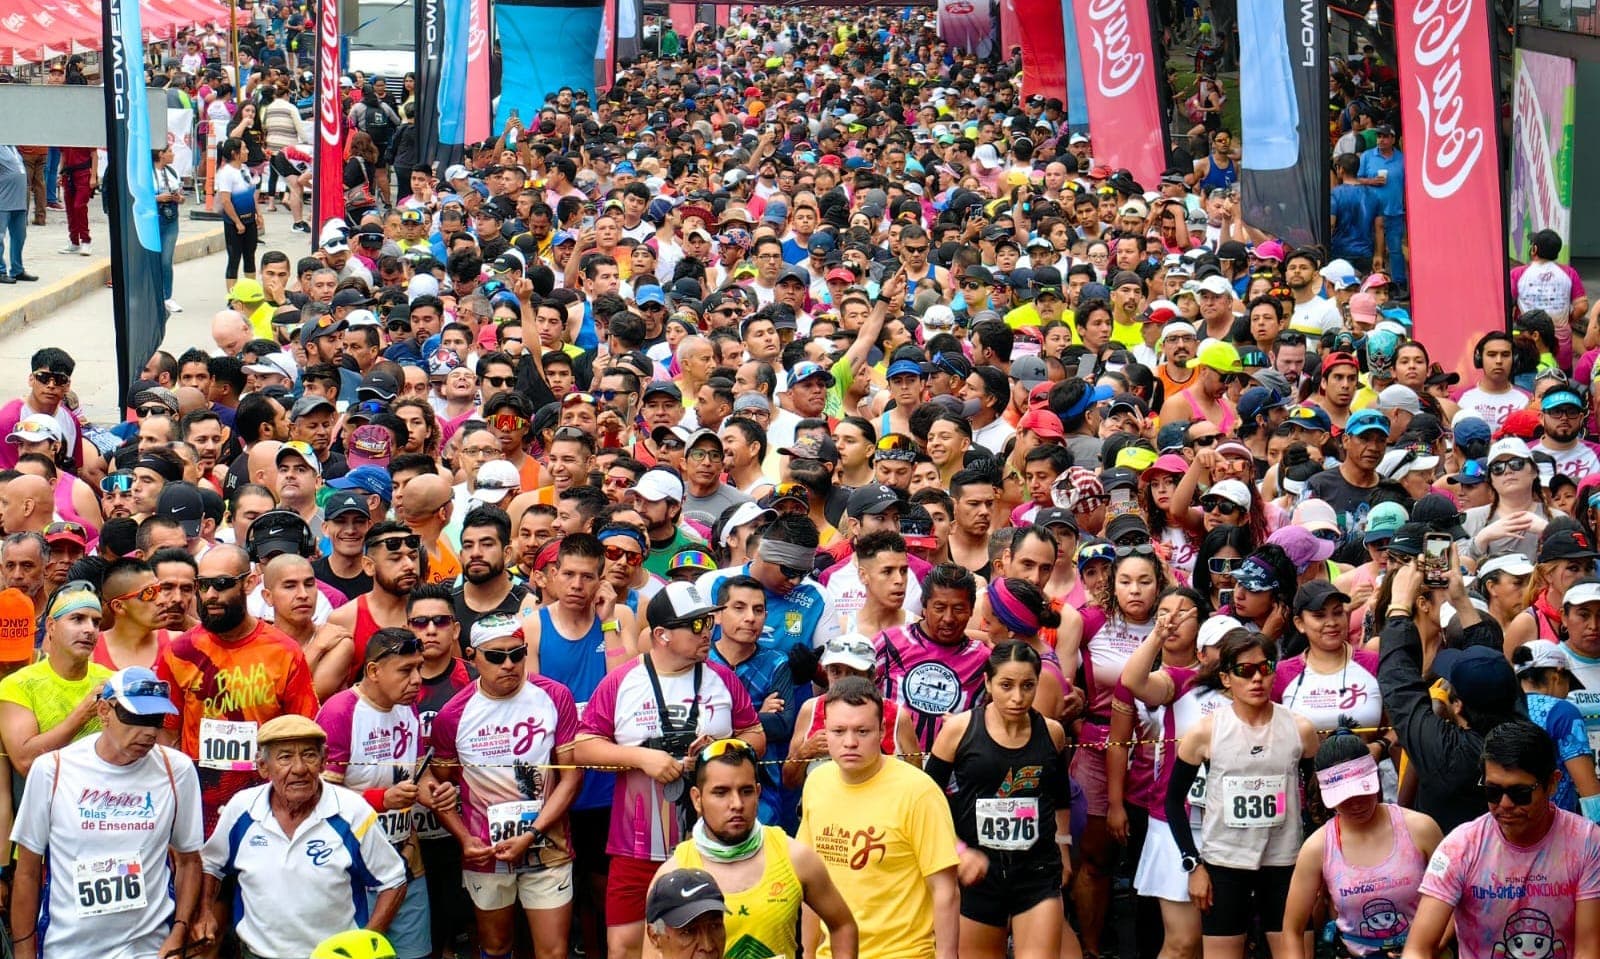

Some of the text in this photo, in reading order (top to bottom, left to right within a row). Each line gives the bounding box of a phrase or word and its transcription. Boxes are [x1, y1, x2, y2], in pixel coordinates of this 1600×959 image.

[426, 0, 438, 60] POW
[204, 738, 250, 760] 1001
[482, 748, 511, 756] TIJUANA
[78, 807, 106, 819] Telas
[1233, 795, 1277, 819] 836
[81, 820, 155, 831] de Ensenada
[490, 820, 536, 842] 386
[981, 817, 1035, 840] 4376
[824, 855, 848, 864] TIJUANA
[78, 873, 141, 907] 5676
